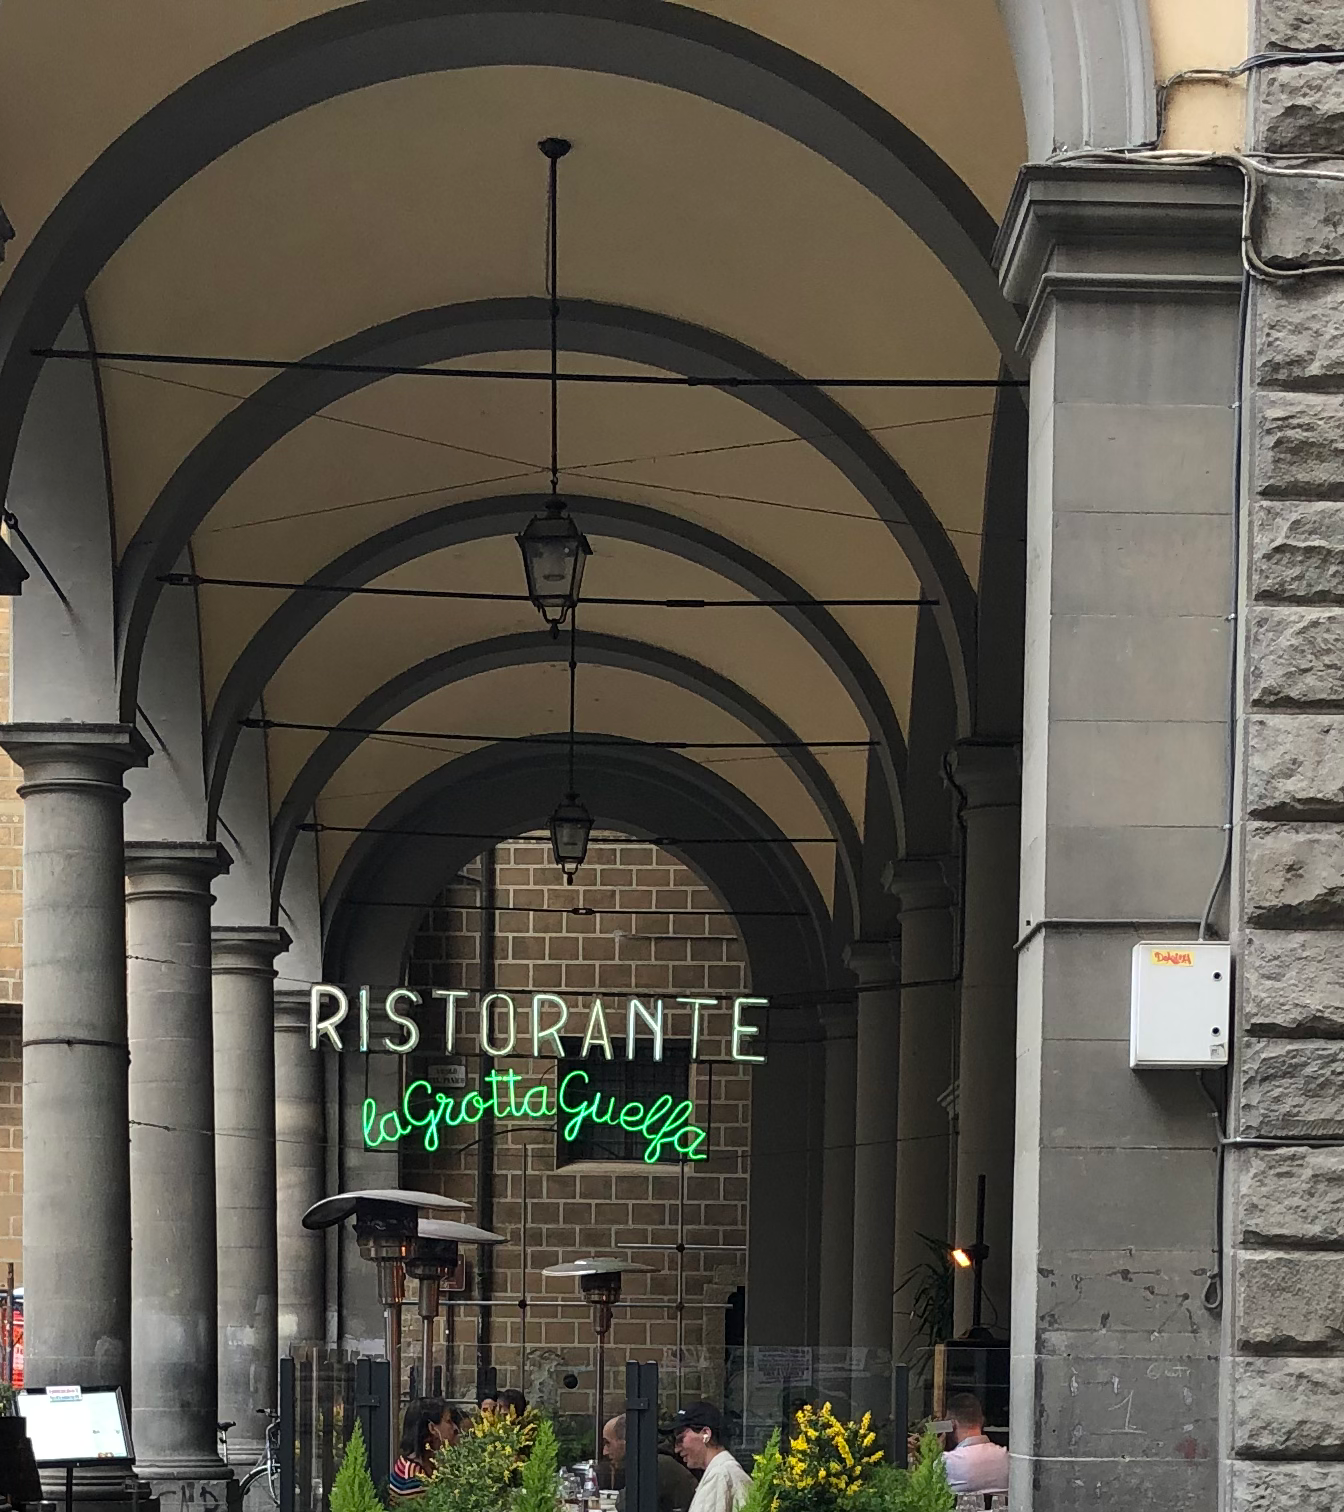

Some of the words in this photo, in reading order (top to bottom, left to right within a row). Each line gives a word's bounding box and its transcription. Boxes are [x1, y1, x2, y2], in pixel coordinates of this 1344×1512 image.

[309, 983, 769, 1064] RISTORANTE
[363, 1098, 412, 1146] la
[403, 1068, 557, 1151] Grotta
[559, 1069, 708, 1163] Guelfa
